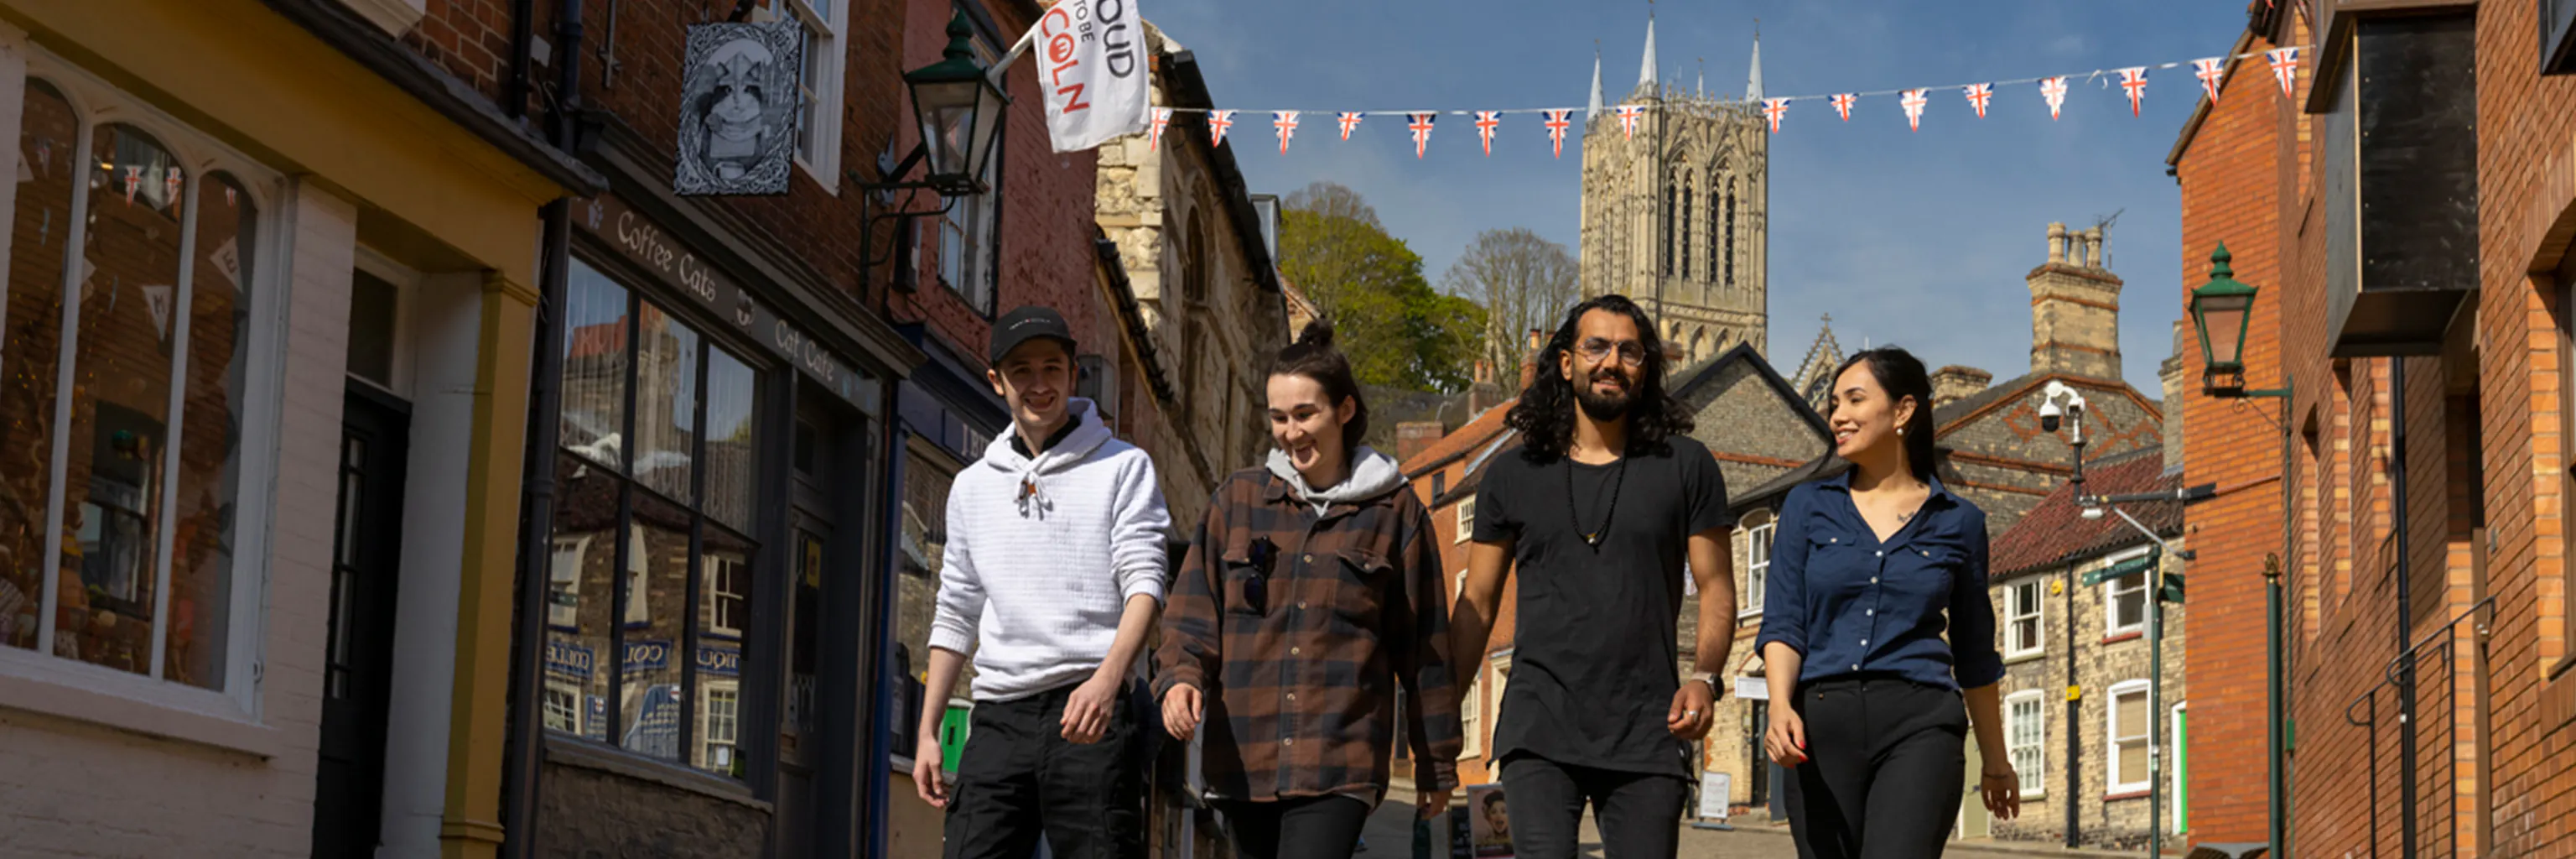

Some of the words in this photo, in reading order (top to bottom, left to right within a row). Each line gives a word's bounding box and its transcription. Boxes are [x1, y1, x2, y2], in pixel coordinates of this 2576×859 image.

[1073, 0, 1088, 20] TO
[1078, 20, 1095, 43] BE
[617, 210, 673, 273] Coffee
[678, 257, 717, 302] Cats
[775, 319, 800, 357] Cat
[805, 340, 834, 382] Cafe
